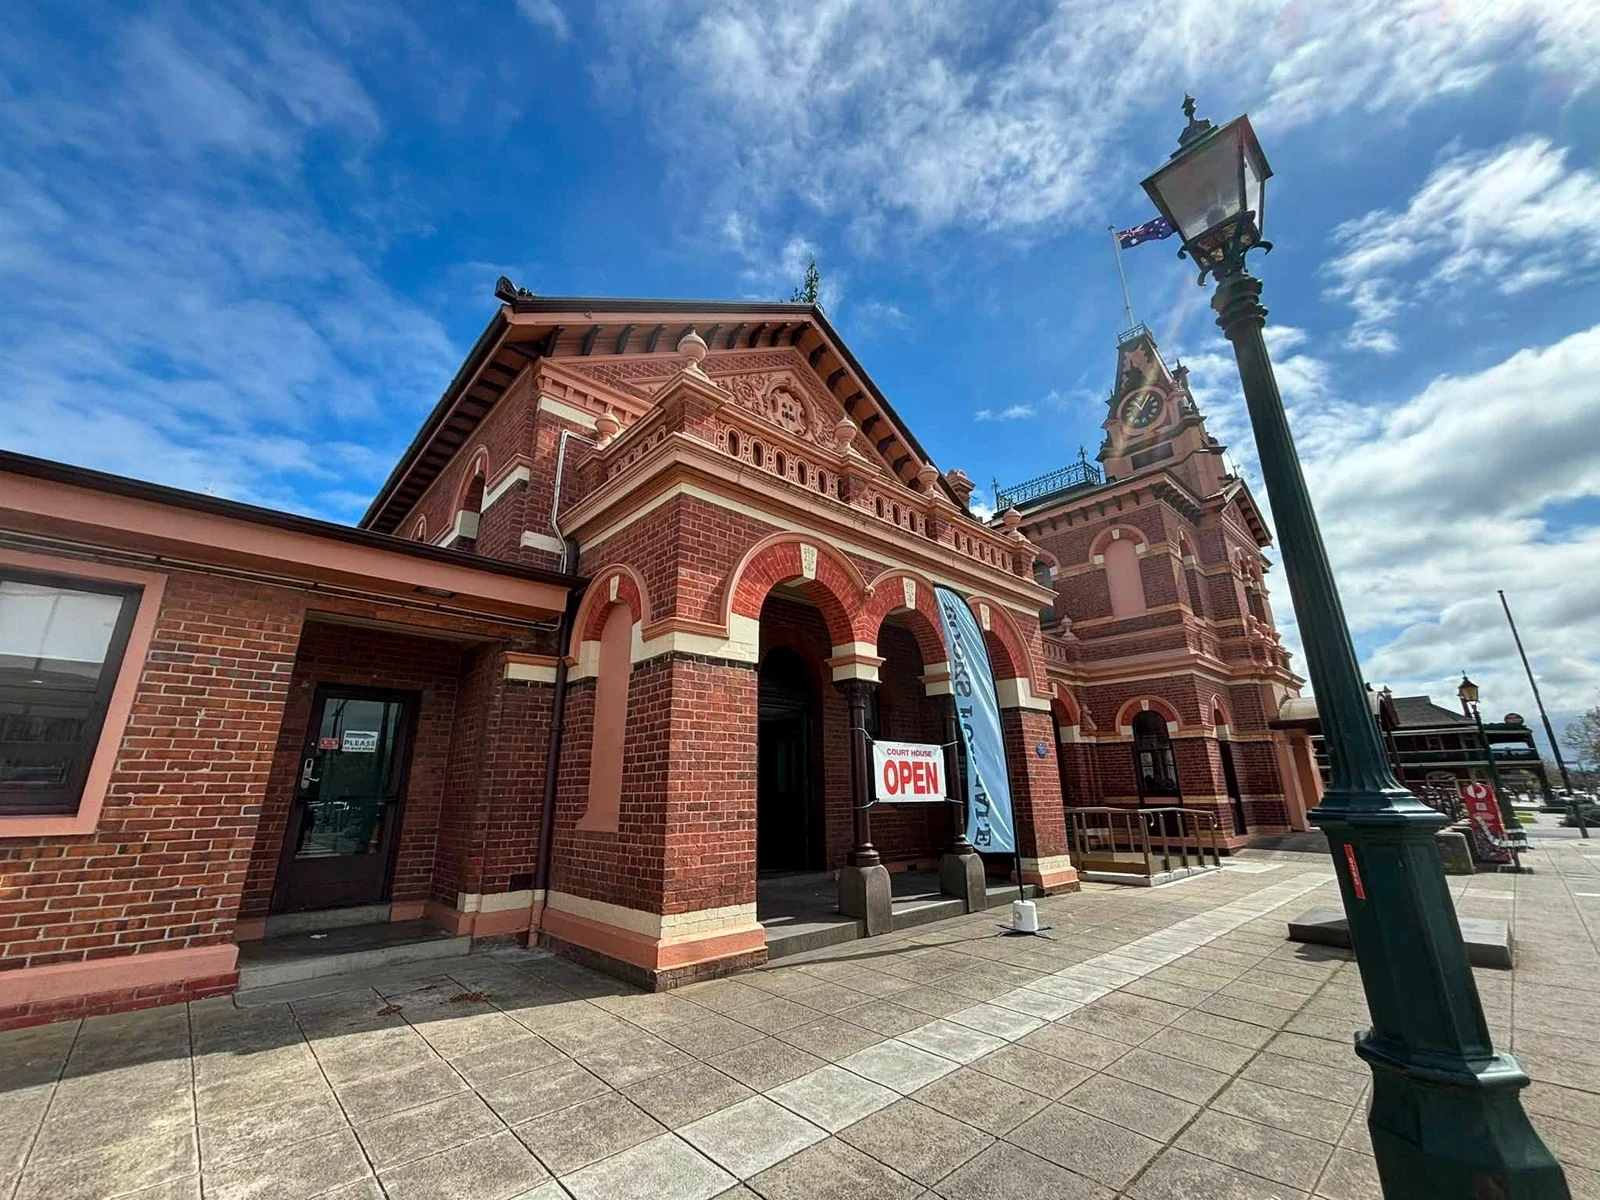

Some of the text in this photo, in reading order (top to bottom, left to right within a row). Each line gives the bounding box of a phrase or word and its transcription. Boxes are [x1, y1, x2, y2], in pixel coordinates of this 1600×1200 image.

[344, 739, 376, 747] PLEASE
[886, 748, 909, 757] COURT
[883, 759, 939, 795] OPEN
